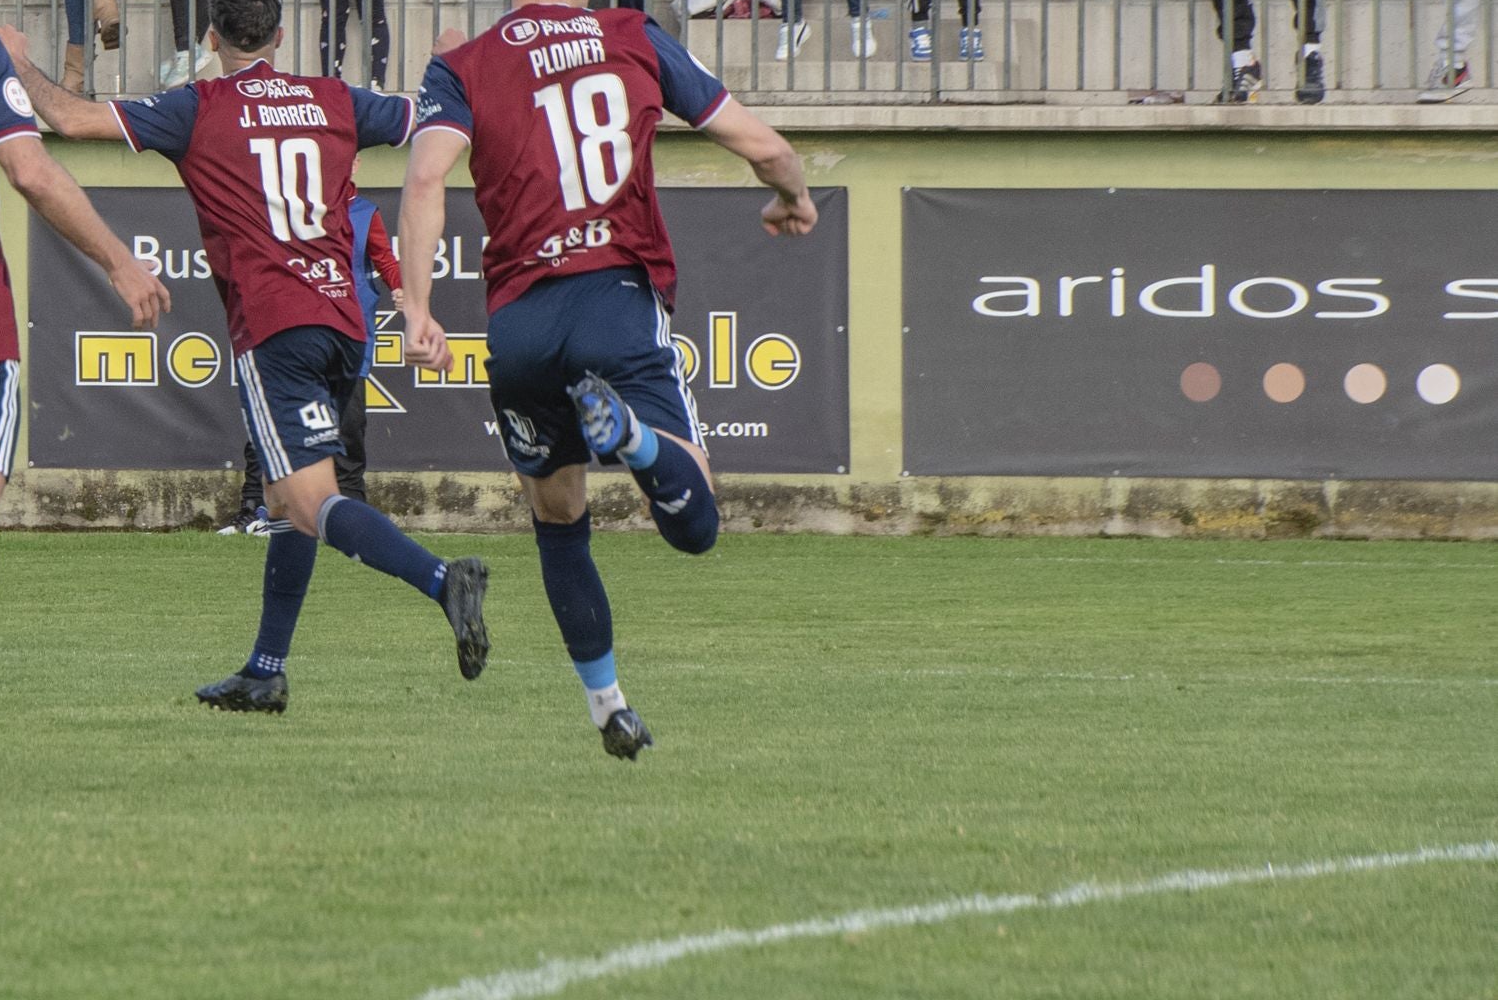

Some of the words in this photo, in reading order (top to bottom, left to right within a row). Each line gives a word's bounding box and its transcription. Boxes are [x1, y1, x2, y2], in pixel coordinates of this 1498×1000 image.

[529, 38, 606, 79] PLOMER
[239, 104, 257, 128] J.
[258, 103, 328, 127] BORREGO
[533, 72, 633, 211] 18
[249, 137, 328, 242] 10
[971, 263, 1392, 319] aridos
